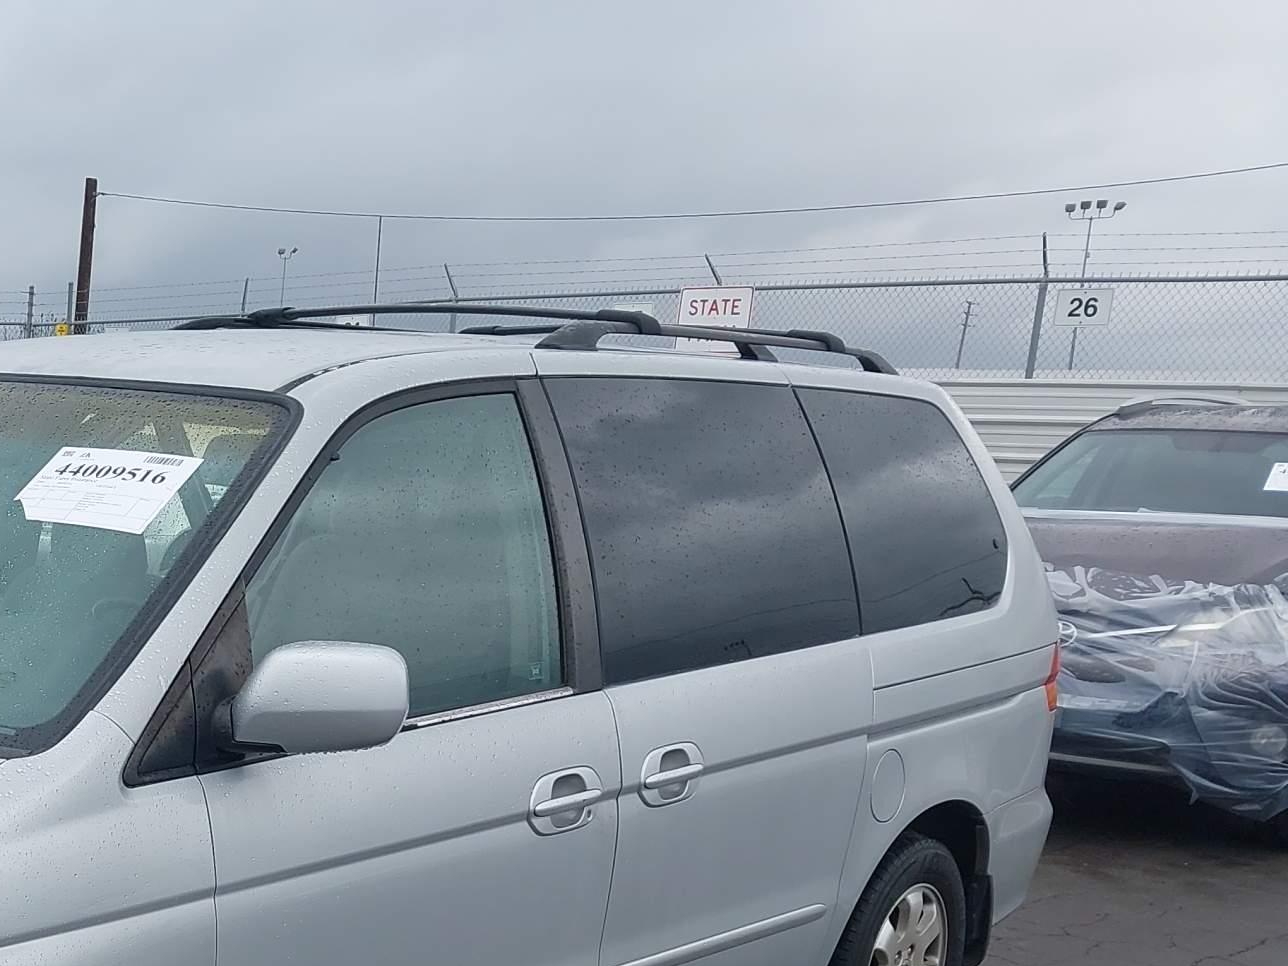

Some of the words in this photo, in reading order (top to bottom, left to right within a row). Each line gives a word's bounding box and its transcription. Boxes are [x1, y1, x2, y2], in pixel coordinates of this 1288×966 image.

[688, 298, 742, 316] STATE
[1067, 296, 1099, 318] 26
[54, 462, 169, 485] 44009516
